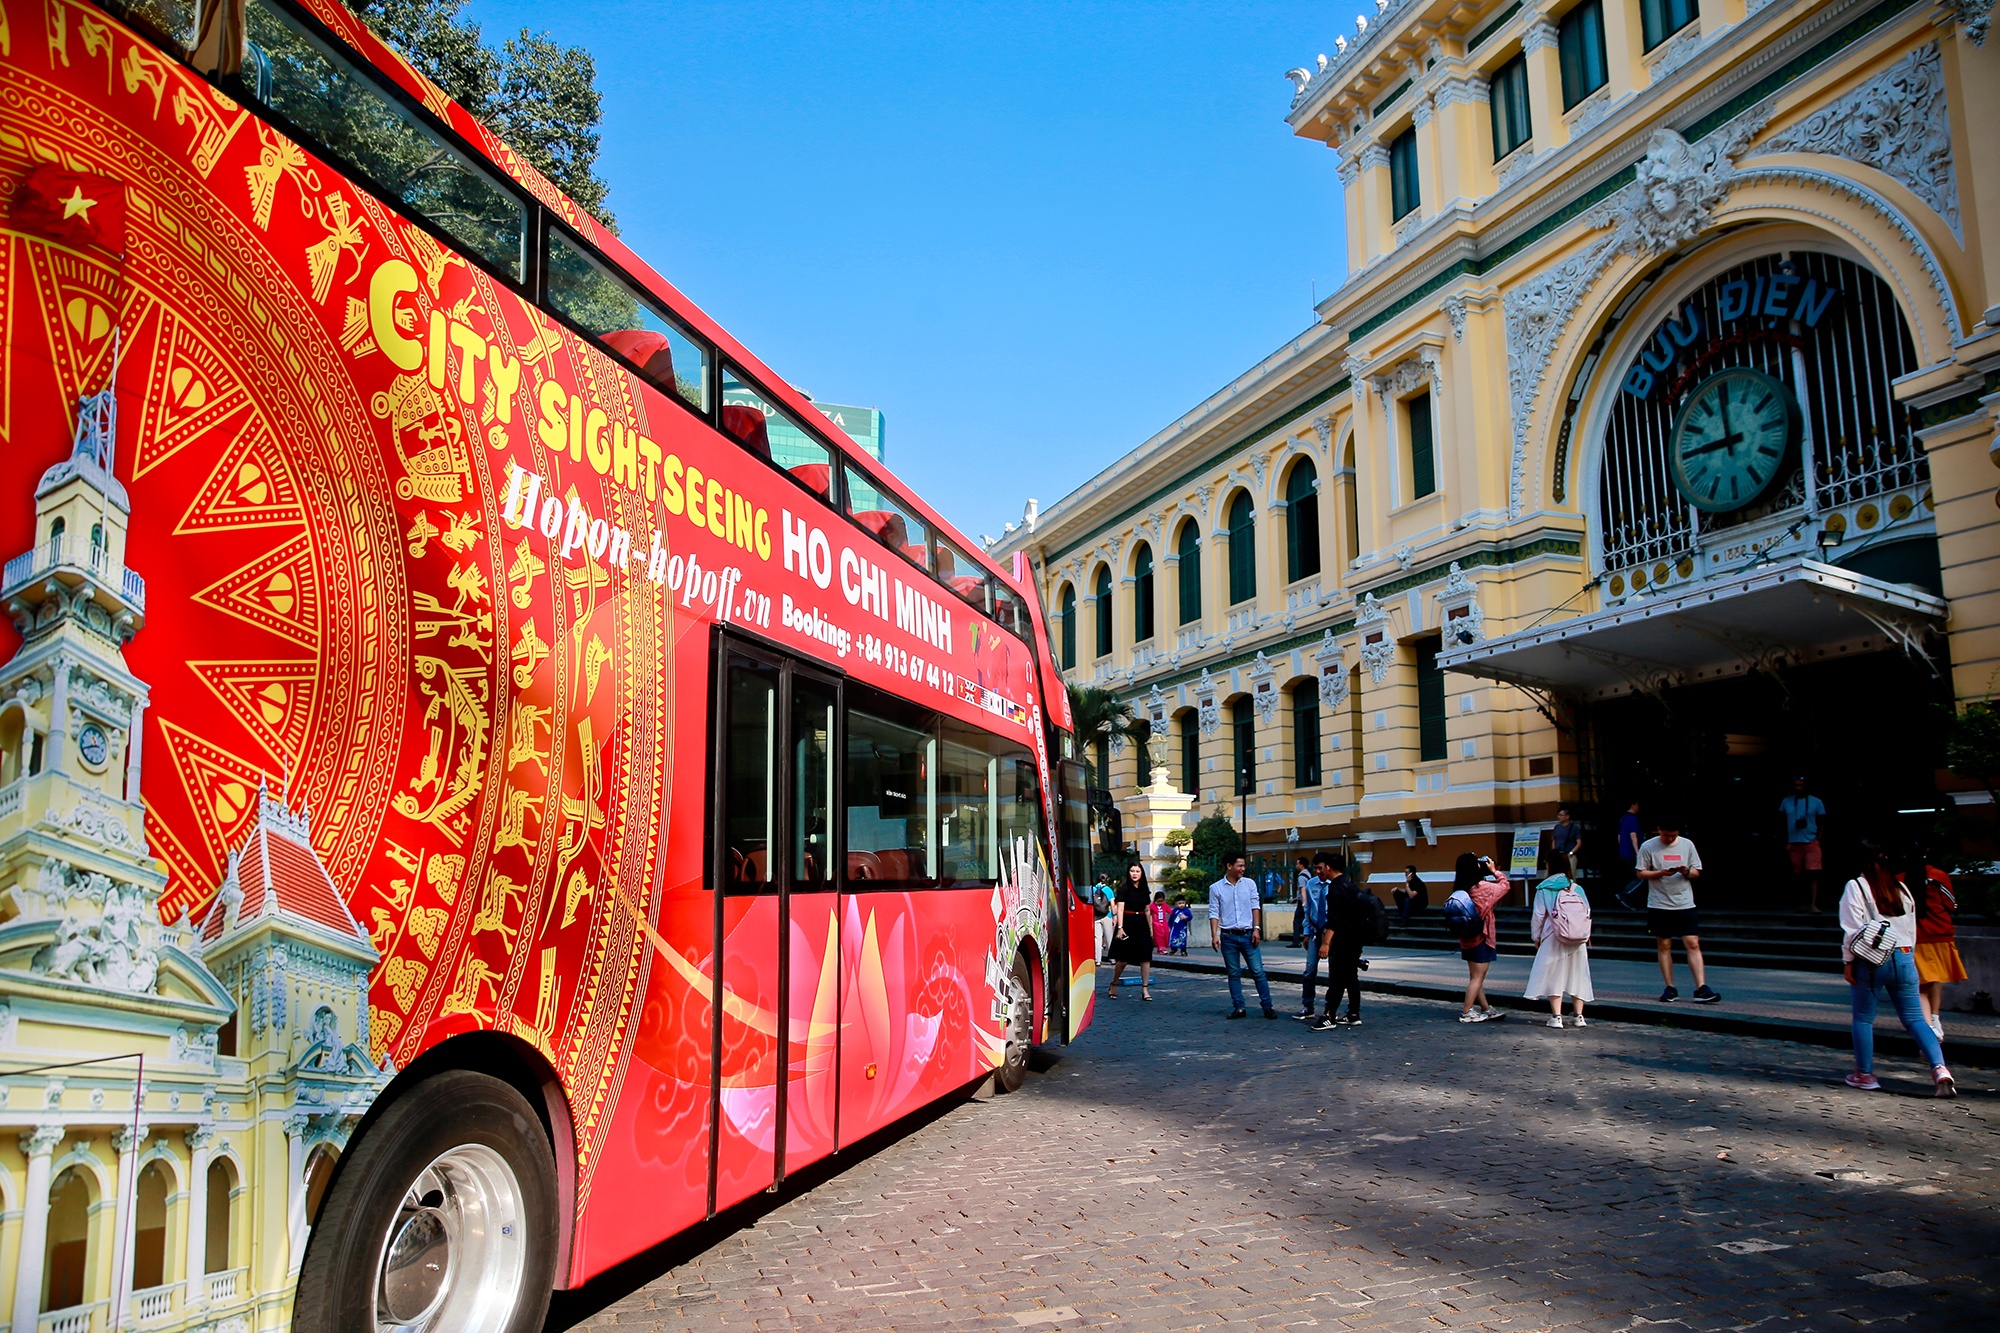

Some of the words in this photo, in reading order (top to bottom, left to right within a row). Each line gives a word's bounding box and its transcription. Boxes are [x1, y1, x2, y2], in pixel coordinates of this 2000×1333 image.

[369, 259, 521, 424] CITY
[538, 380, 771, 561] SIGHTSEEING
[500, 464, 771, 629] Hopon-hopoff.vn
[782, 508, 832, 590] HO
[840, 546, 889, 622] CHI
[894, 577, 953, 655] MINH
[782, 593, 851, 658] Booking:
[855, 633, 882, 666] +84
[884, 642, 908, 677] 913
[910, 655, 925, 683] 67
[926, 662, 940, 691] 44
[942, 669, 955, 697] 12
